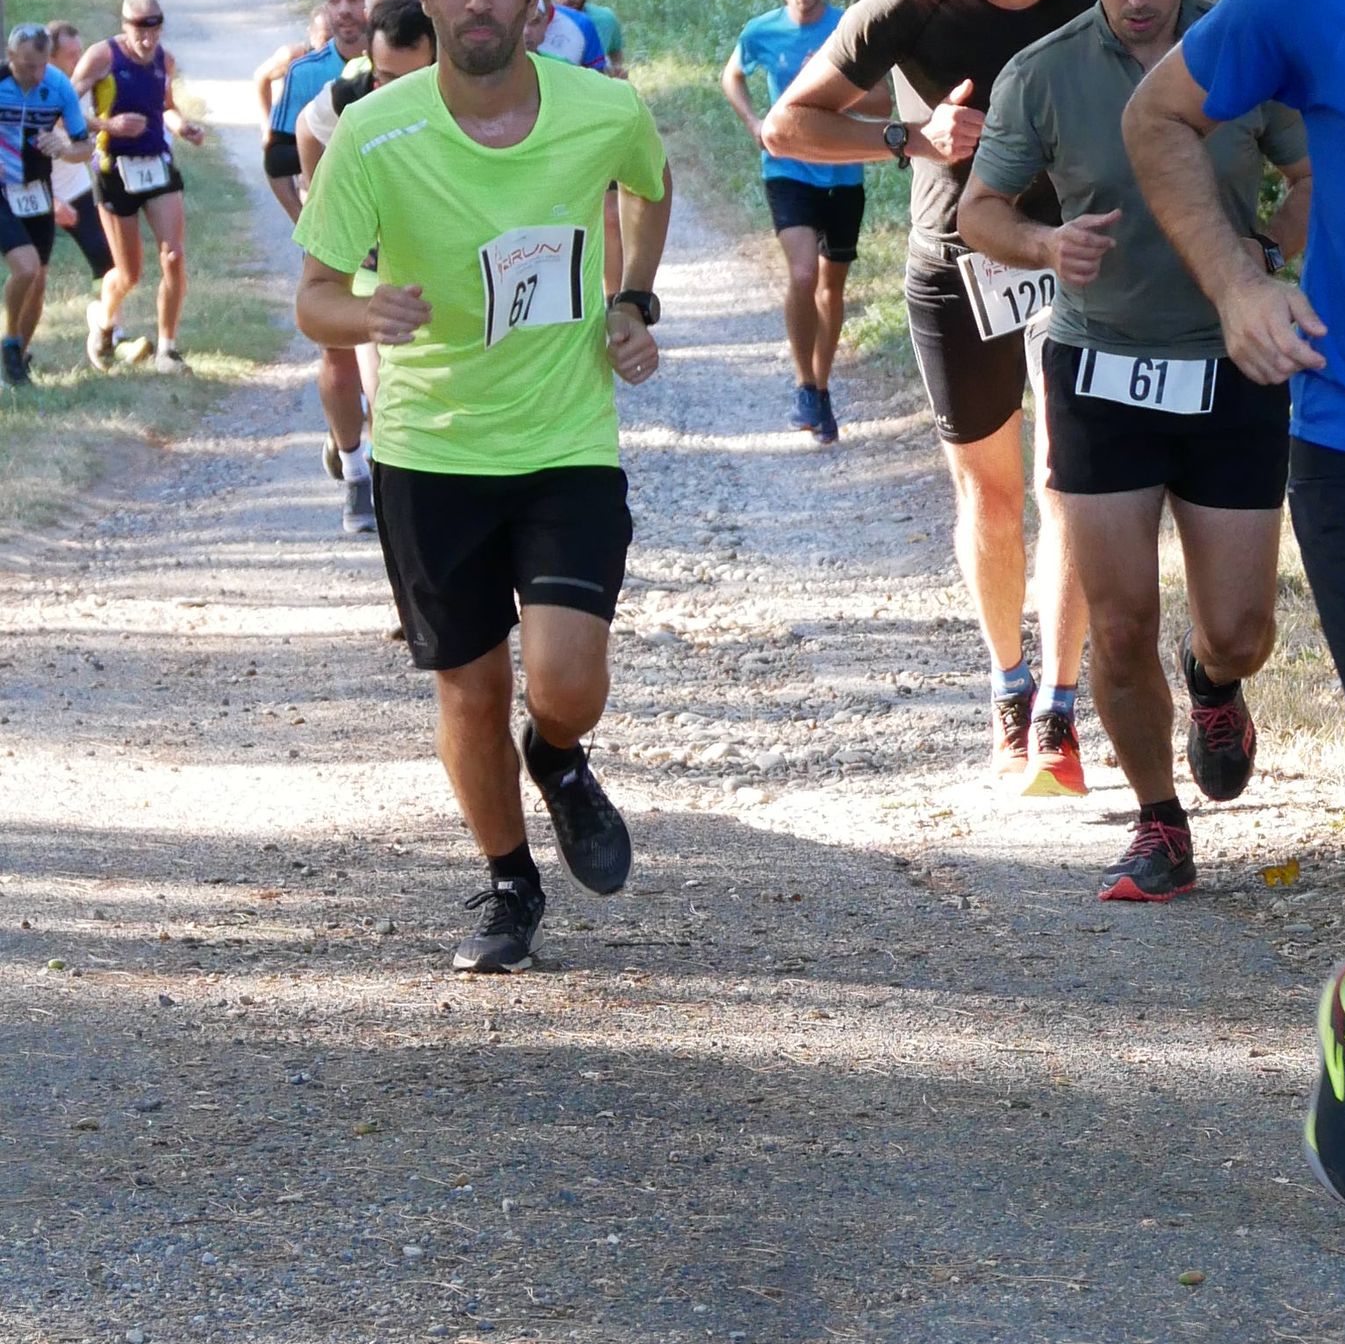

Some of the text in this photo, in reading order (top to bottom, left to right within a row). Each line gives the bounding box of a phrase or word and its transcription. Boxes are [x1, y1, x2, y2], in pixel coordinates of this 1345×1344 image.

[509, 274, 538, 327] 67
[1003, 274, 1056, 323] 120
[1129, 358, 1168, 404] 61
